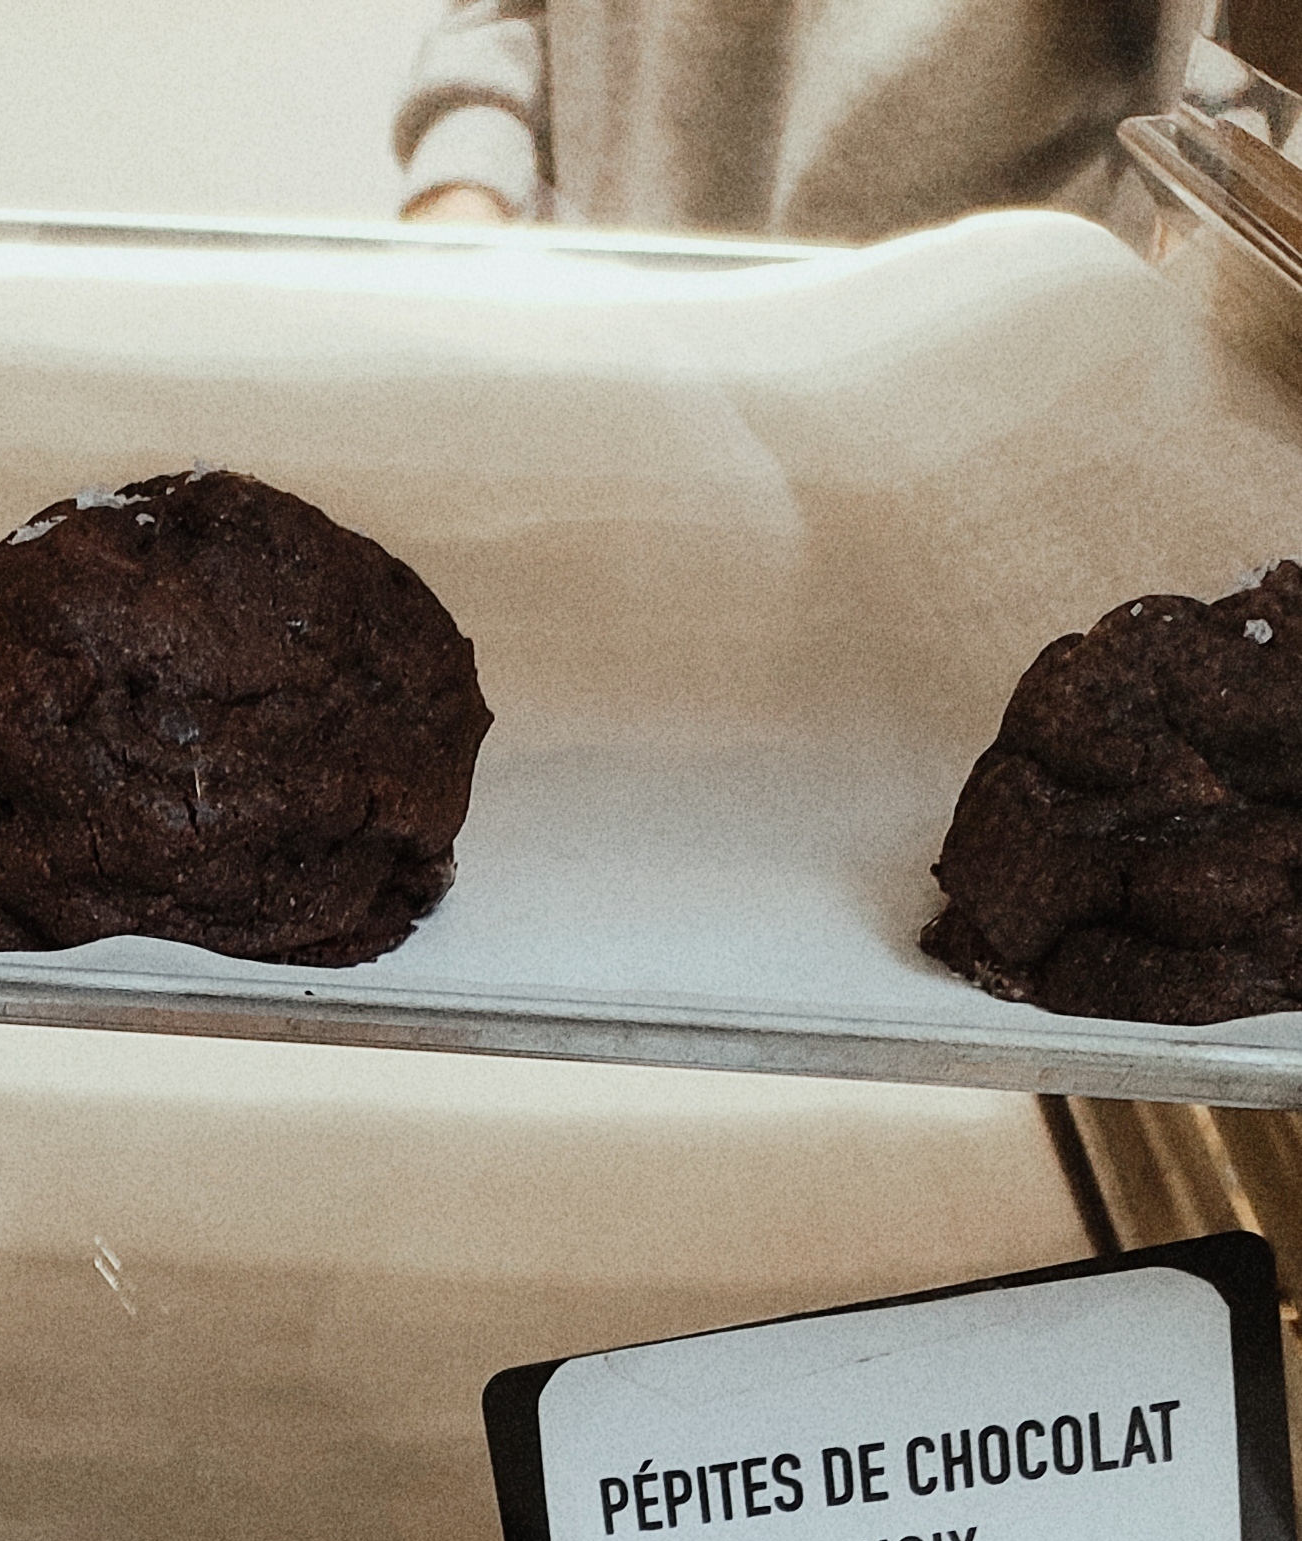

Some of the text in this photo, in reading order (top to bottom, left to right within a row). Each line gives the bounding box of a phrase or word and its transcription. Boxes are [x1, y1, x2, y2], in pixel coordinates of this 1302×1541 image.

[599, 1400, 1182, 1536] PÉPITES DE CHOCOLAT
